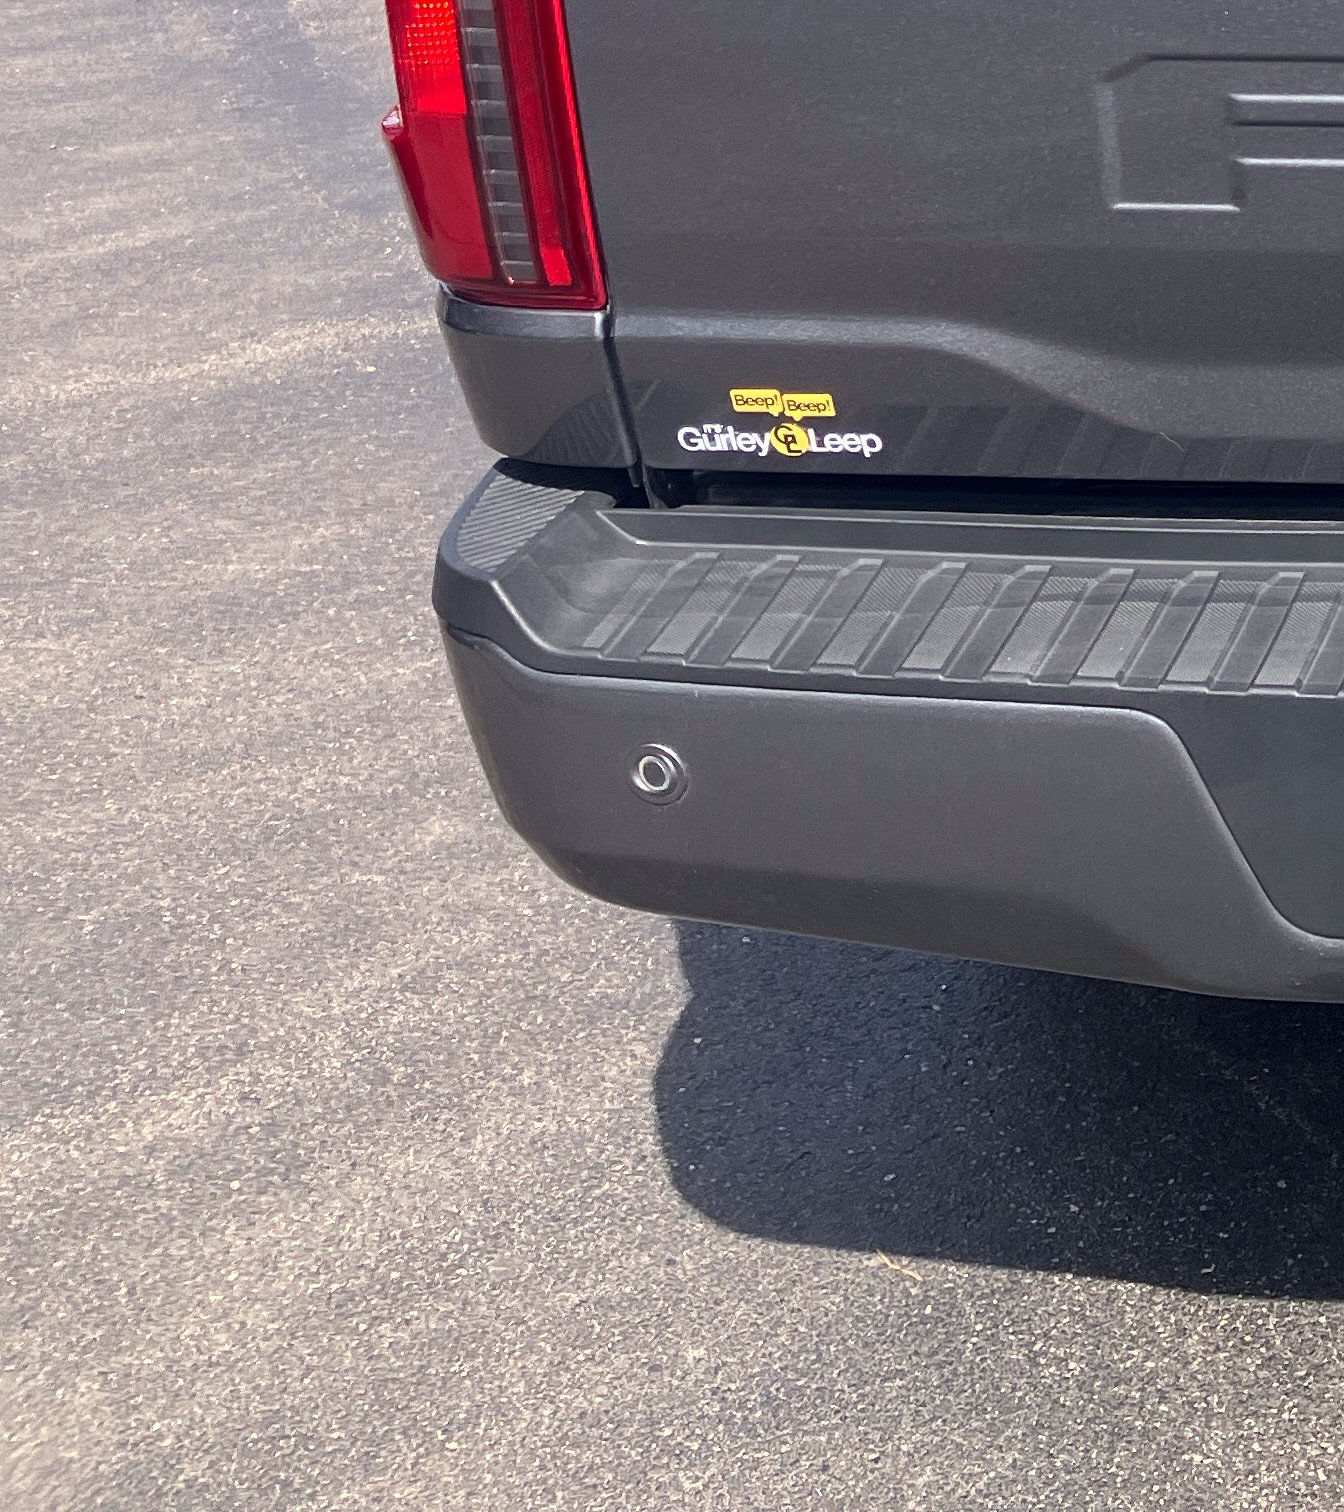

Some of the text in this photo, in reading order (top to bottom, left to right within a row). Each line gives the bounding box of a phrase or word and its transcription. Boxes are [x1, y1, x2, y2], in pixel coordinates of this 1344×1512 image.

[734, 393, 833, 414] Beep! Beep!
[807, 426, 883, 458] Leep
